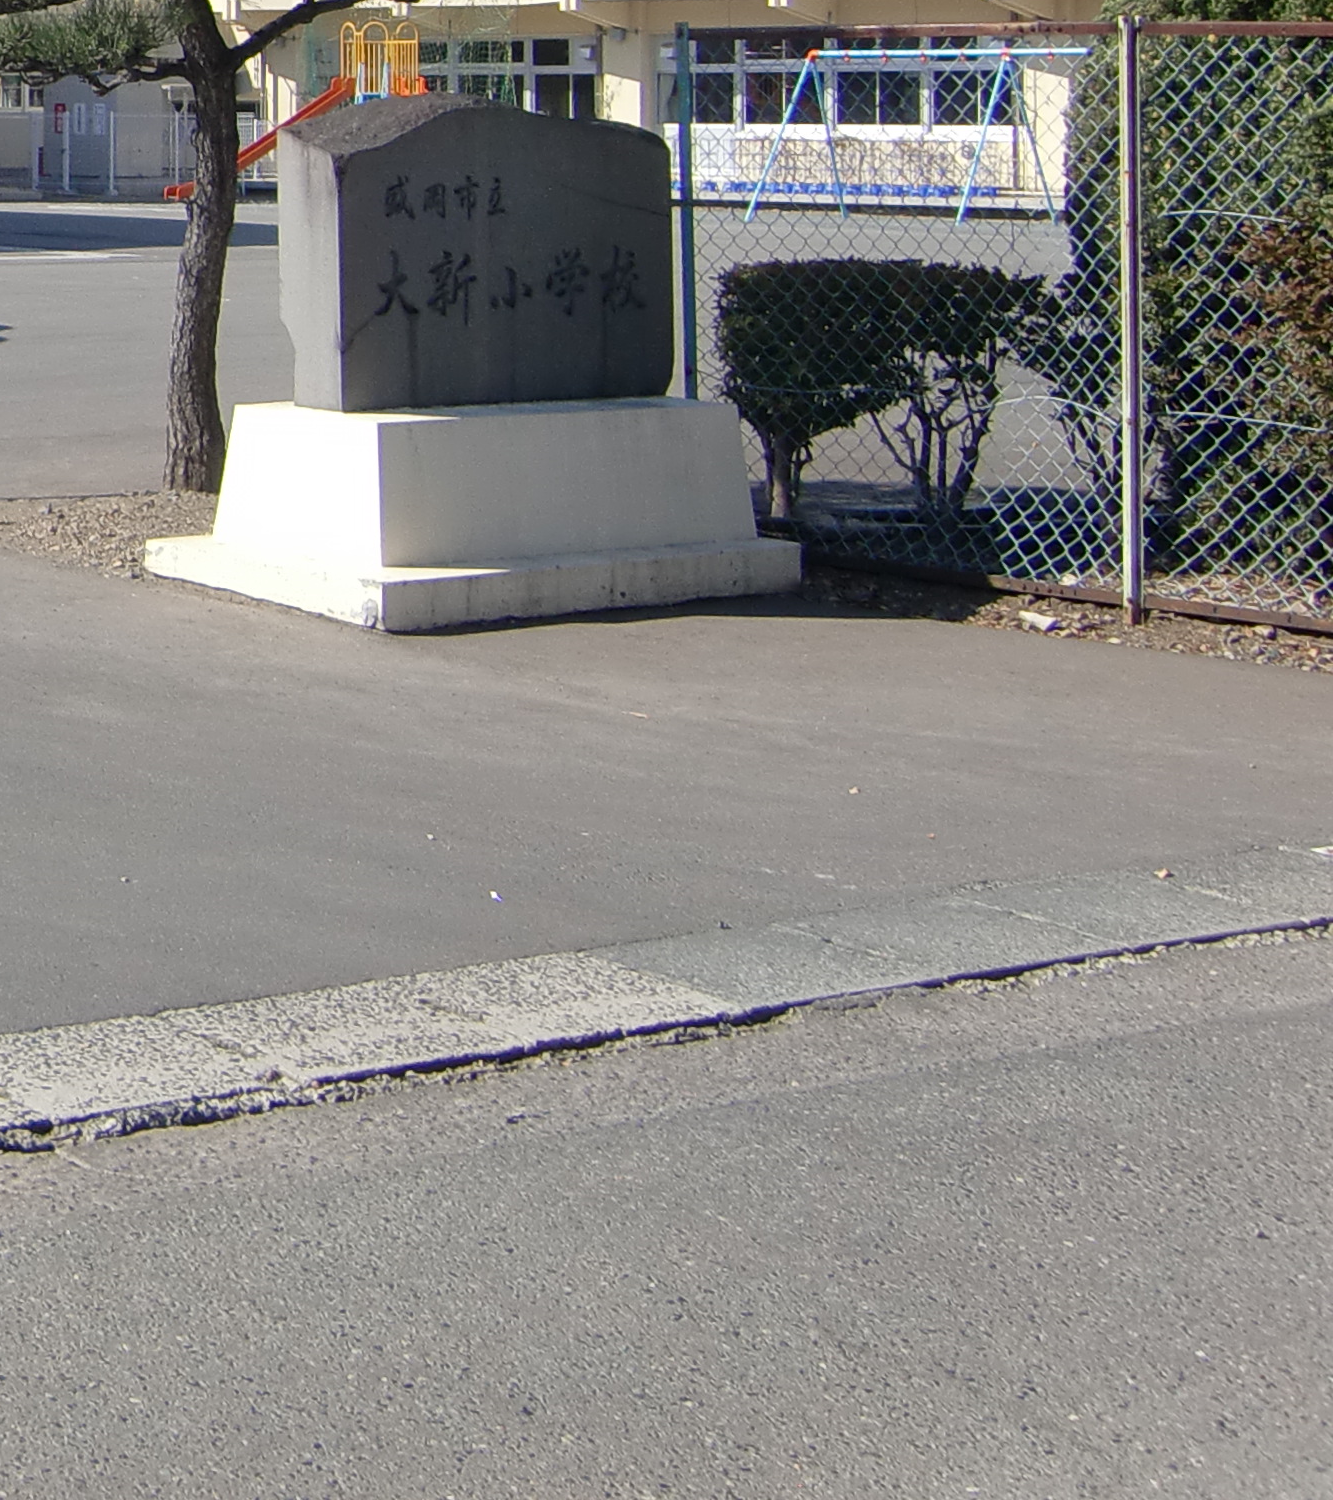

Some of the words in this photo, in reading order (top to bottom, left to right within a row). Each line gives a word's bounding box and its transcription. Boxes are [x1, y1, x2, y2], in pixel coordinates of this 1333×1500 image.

[374, 245, 646, 326] 大新小学校
